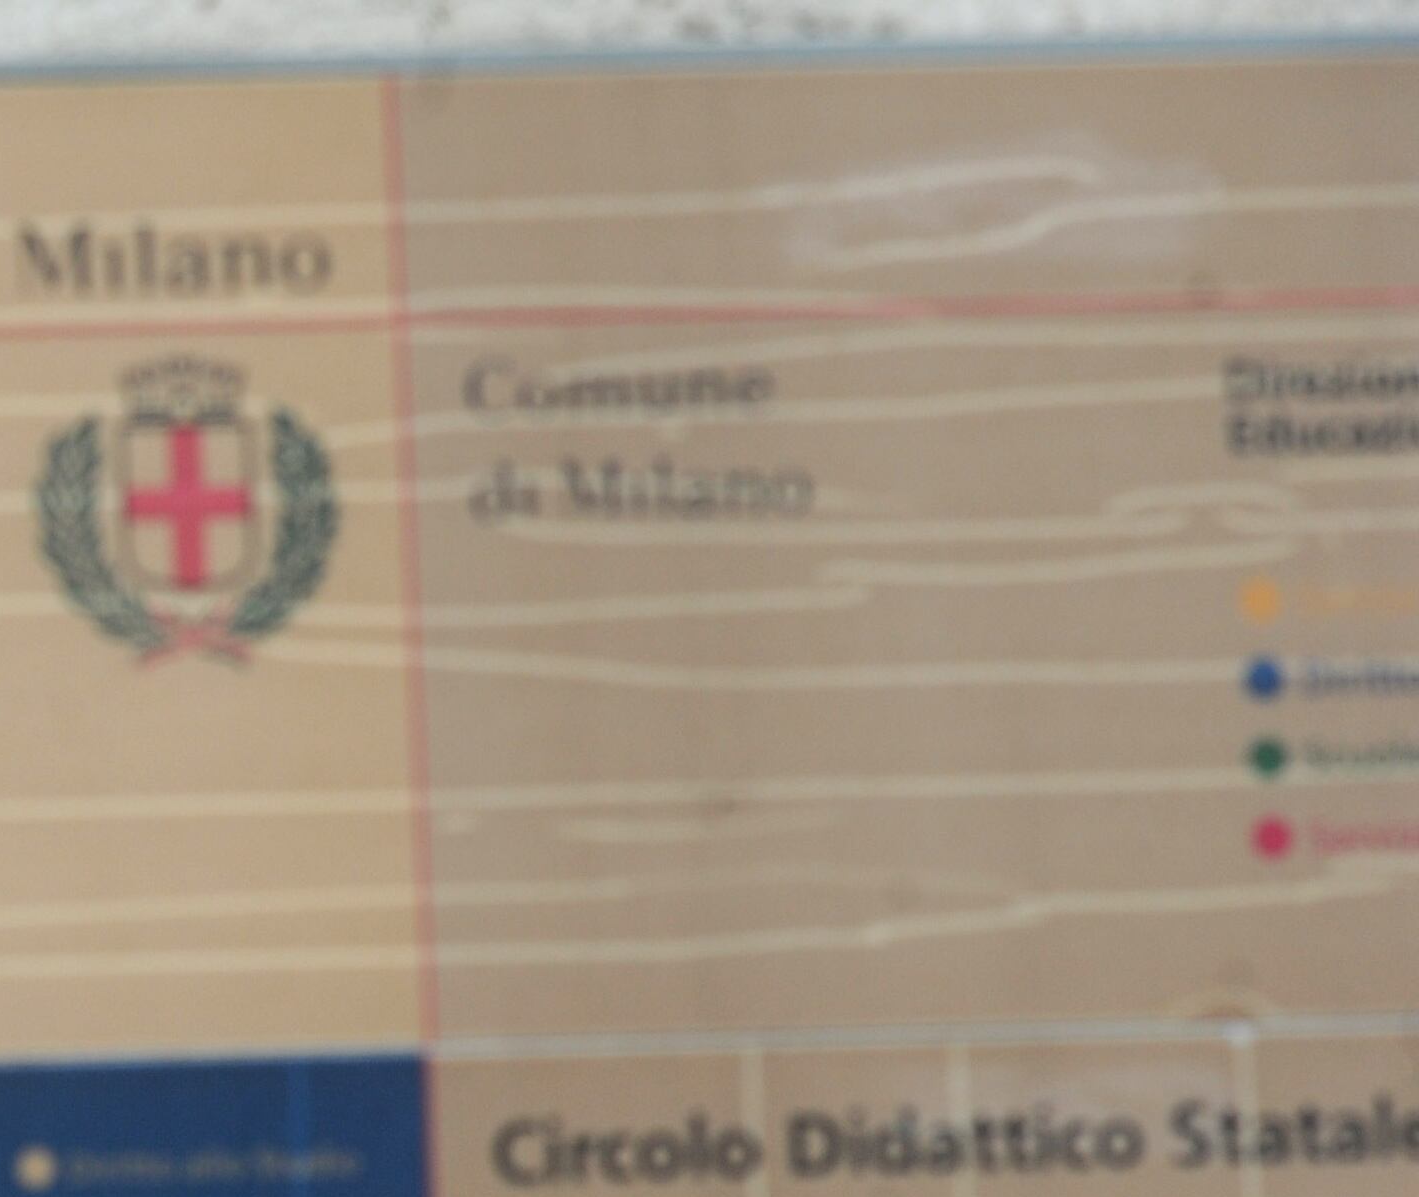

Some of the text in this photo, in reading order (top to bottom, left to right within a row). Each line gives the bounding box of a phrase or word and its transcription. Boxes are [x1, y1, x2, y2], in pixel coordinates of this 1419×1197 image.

[17, 220, 334, 293] Milano
[463, 354, 775, 416] Comune
[468, 453, 816, 526] di Milano
[491, 1109, 761, 1187] Circolo
[787, 1103, 1147, 1179] Didattico
